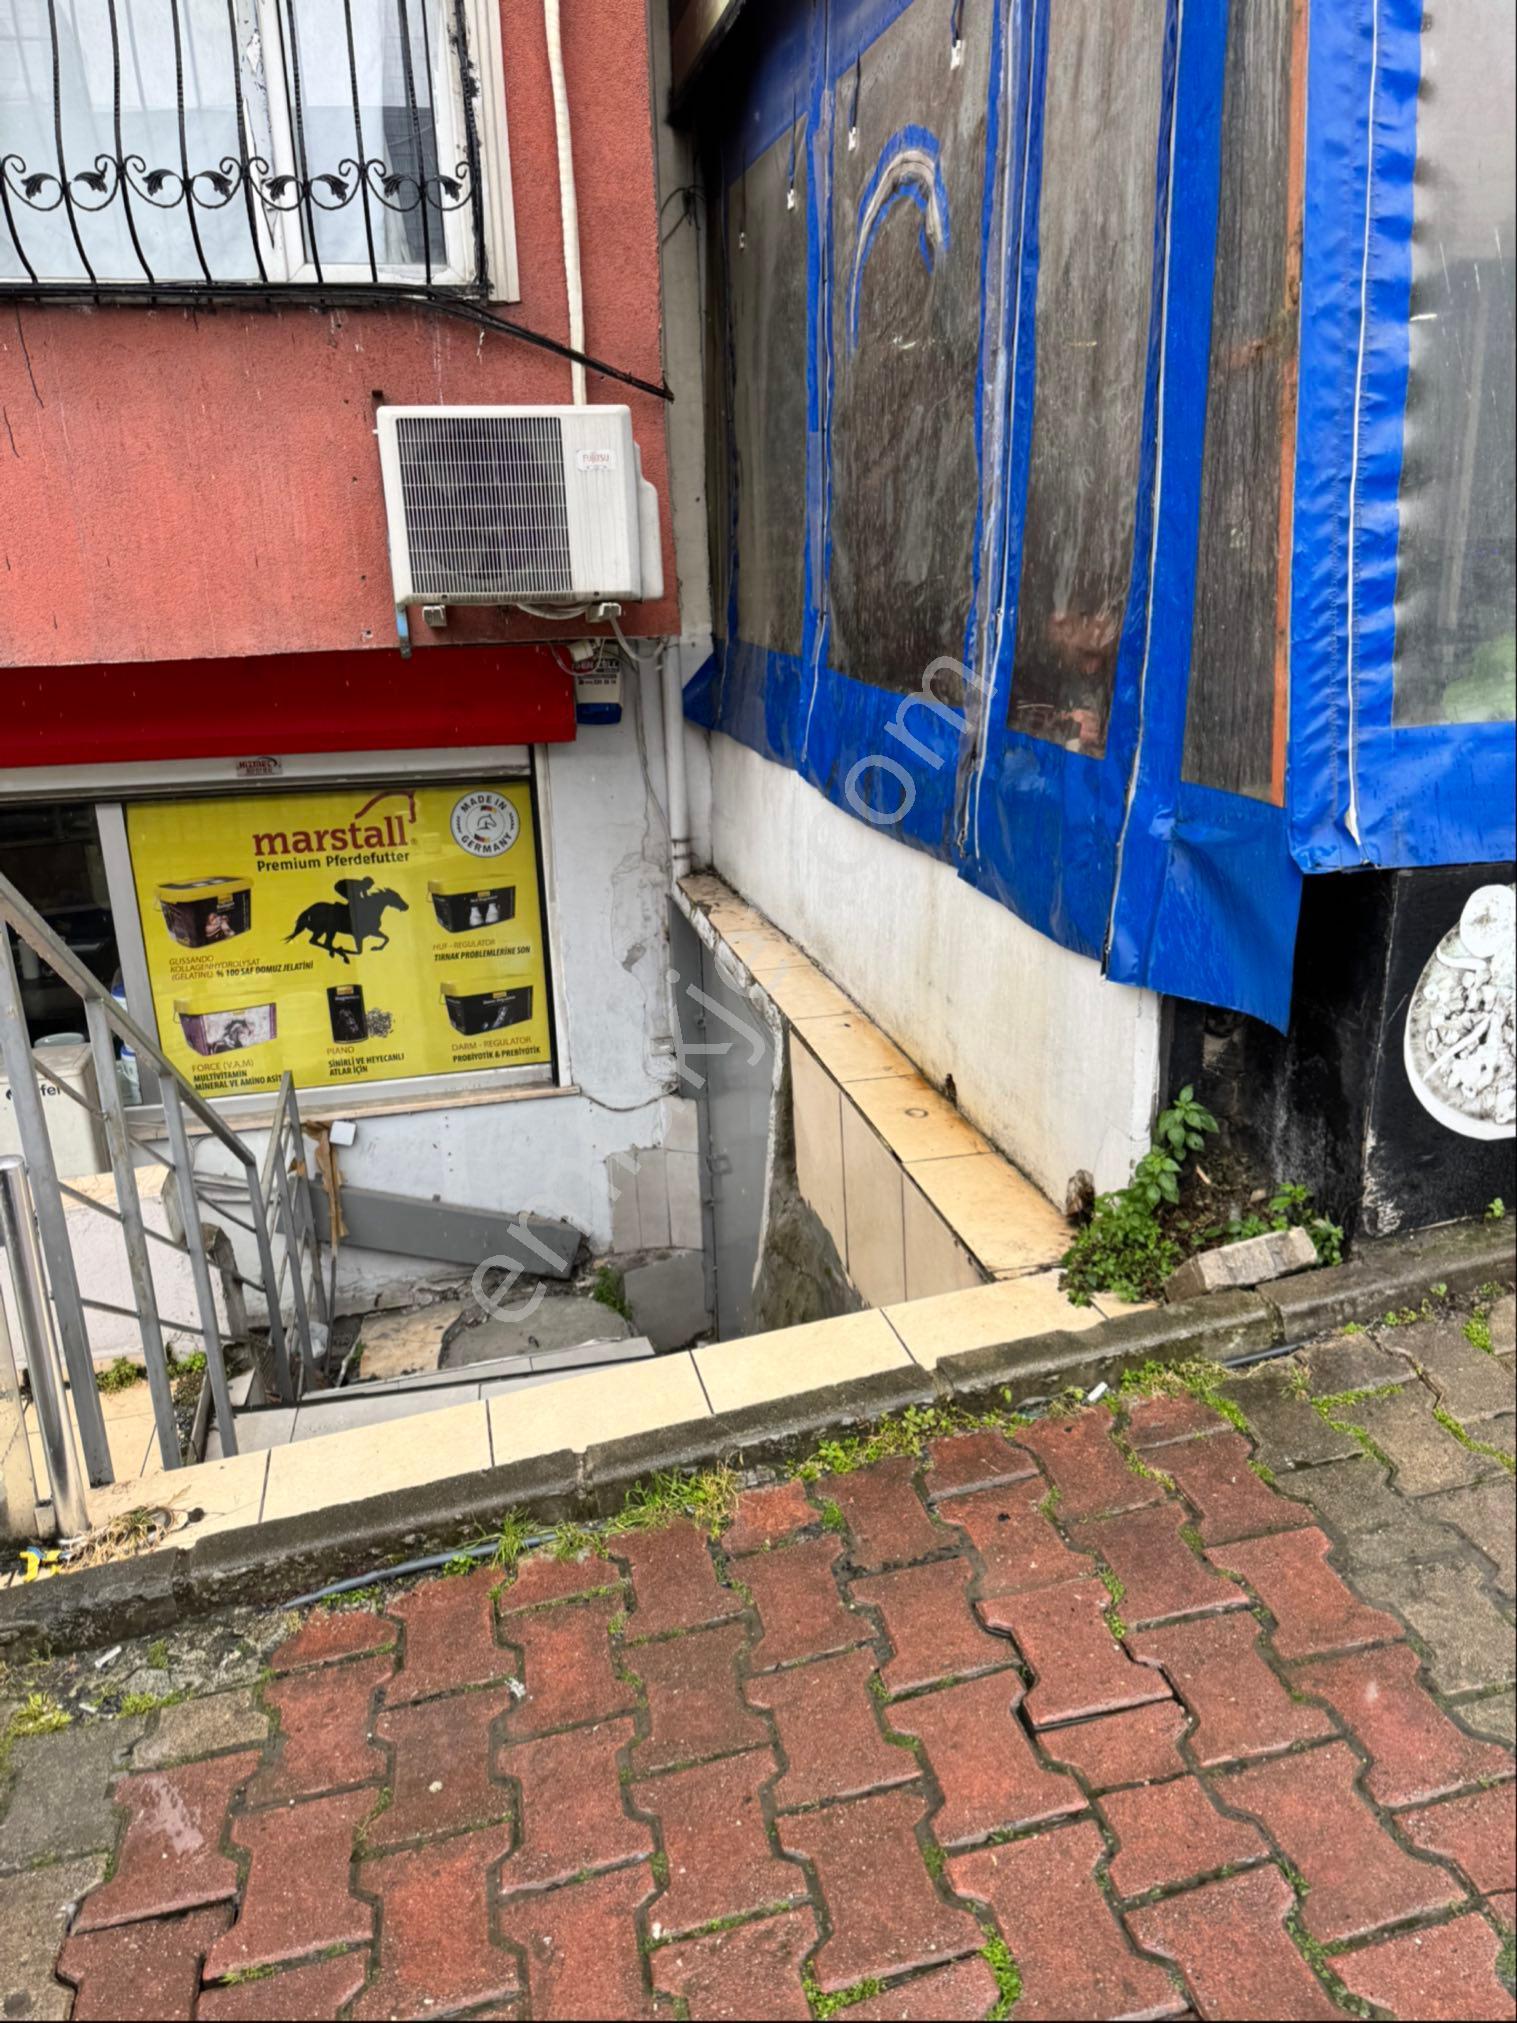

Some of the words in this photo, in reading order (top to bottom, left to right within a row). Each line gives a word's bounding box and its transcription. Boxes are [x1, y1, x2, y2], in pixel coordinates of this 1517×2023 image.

[461, 795, 492, 813] MADE
[495, 798, 507, 810] IN
[252, 815, 408, 856] marstall
[461, 832, 511, 853] GERMANY
[257, 857, 321, 872] Premium
[326, 851, 410, 867] Pferdefutter
[434, 952, 459, 962] TIRNAK
[517, 945, 530, 955] SON
[226, 967, 240, 977] 100
[255, 964, 280, 974] DOMUZ
[484, 1036, 531, 1048] REGULATOR
[356, 1057, 364, 1065] VE
[329, 1067, 352, 1076] ATLAR
[230, 1079, 238, 1087] VE
